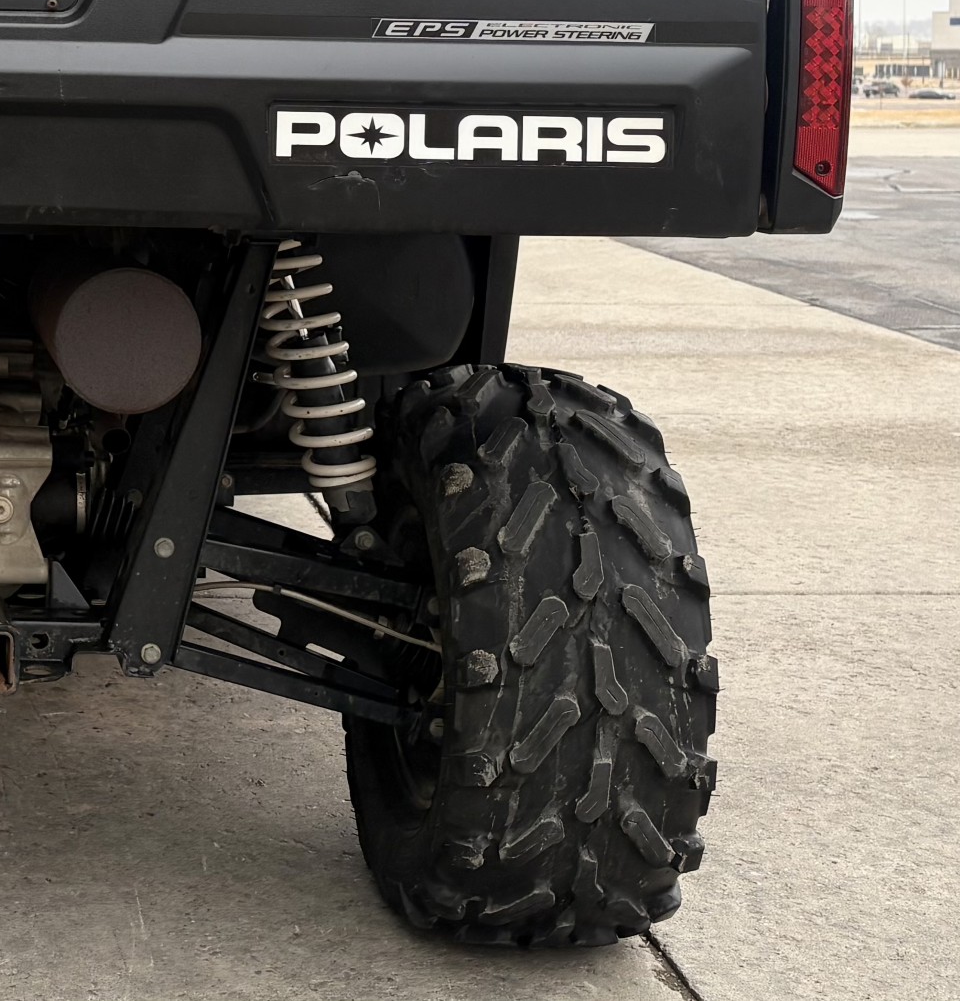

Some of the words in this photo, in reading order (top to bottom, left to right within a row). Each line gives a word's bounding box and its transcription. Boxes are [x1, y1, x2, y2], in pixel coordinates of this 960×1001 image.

[384, 20, 469, 37] EPS
[486, 22, 643, 30] ELECTRONIC
[480, 29, 548, 39] POWER
[551, 30, 642, 40] STEERING
[275, 110, 666, 163] POLARIS
